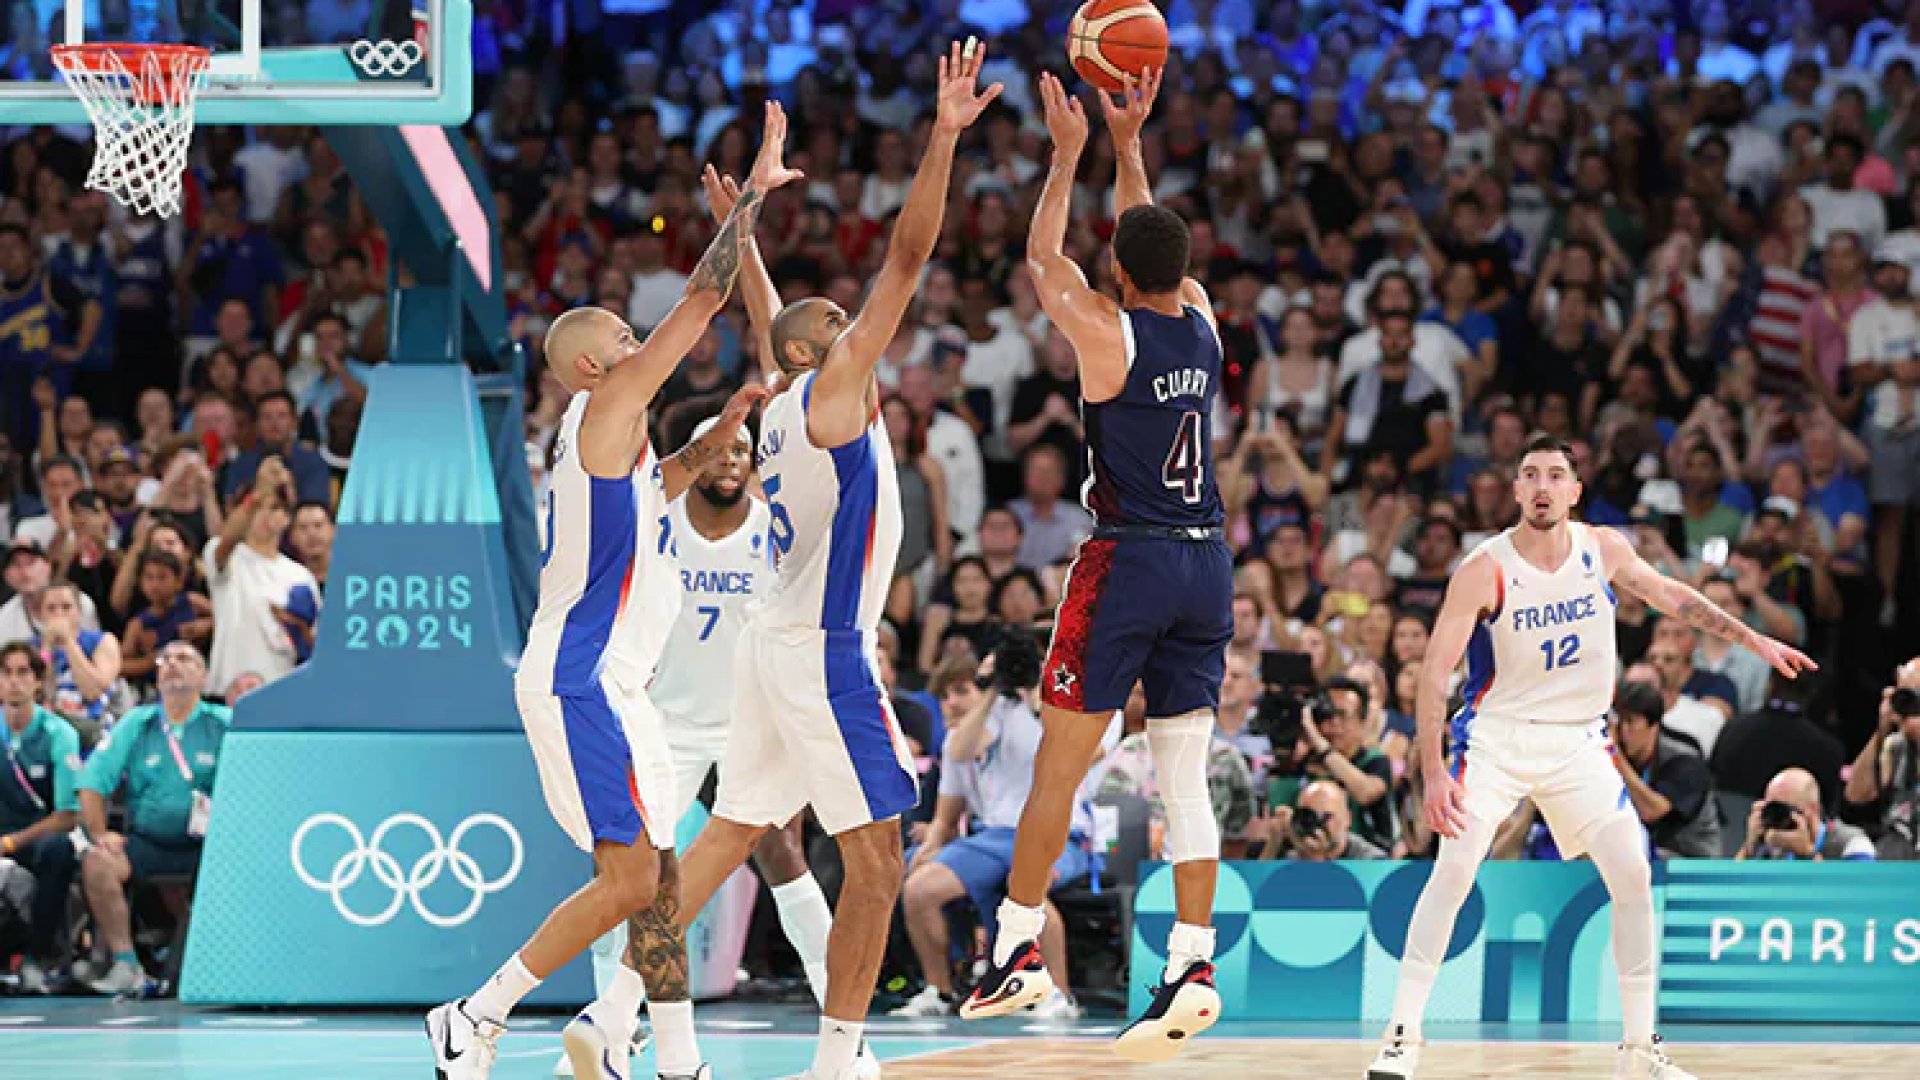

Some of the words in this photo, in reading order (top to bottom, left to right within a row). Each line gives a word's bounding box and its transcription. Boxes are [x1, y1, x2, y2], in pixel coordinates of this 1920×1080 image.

[1162, 411, 1203, 504] 4
[658, 514, 677, 557] 1
[680, 569, 753, 594] RANCE
[698, 606, 720, 641] 7
[1512, 593, 1596, 632] FRANCE
[345, 615, 472, 648] 2024
[1540, 634, 1581, 671] 12
